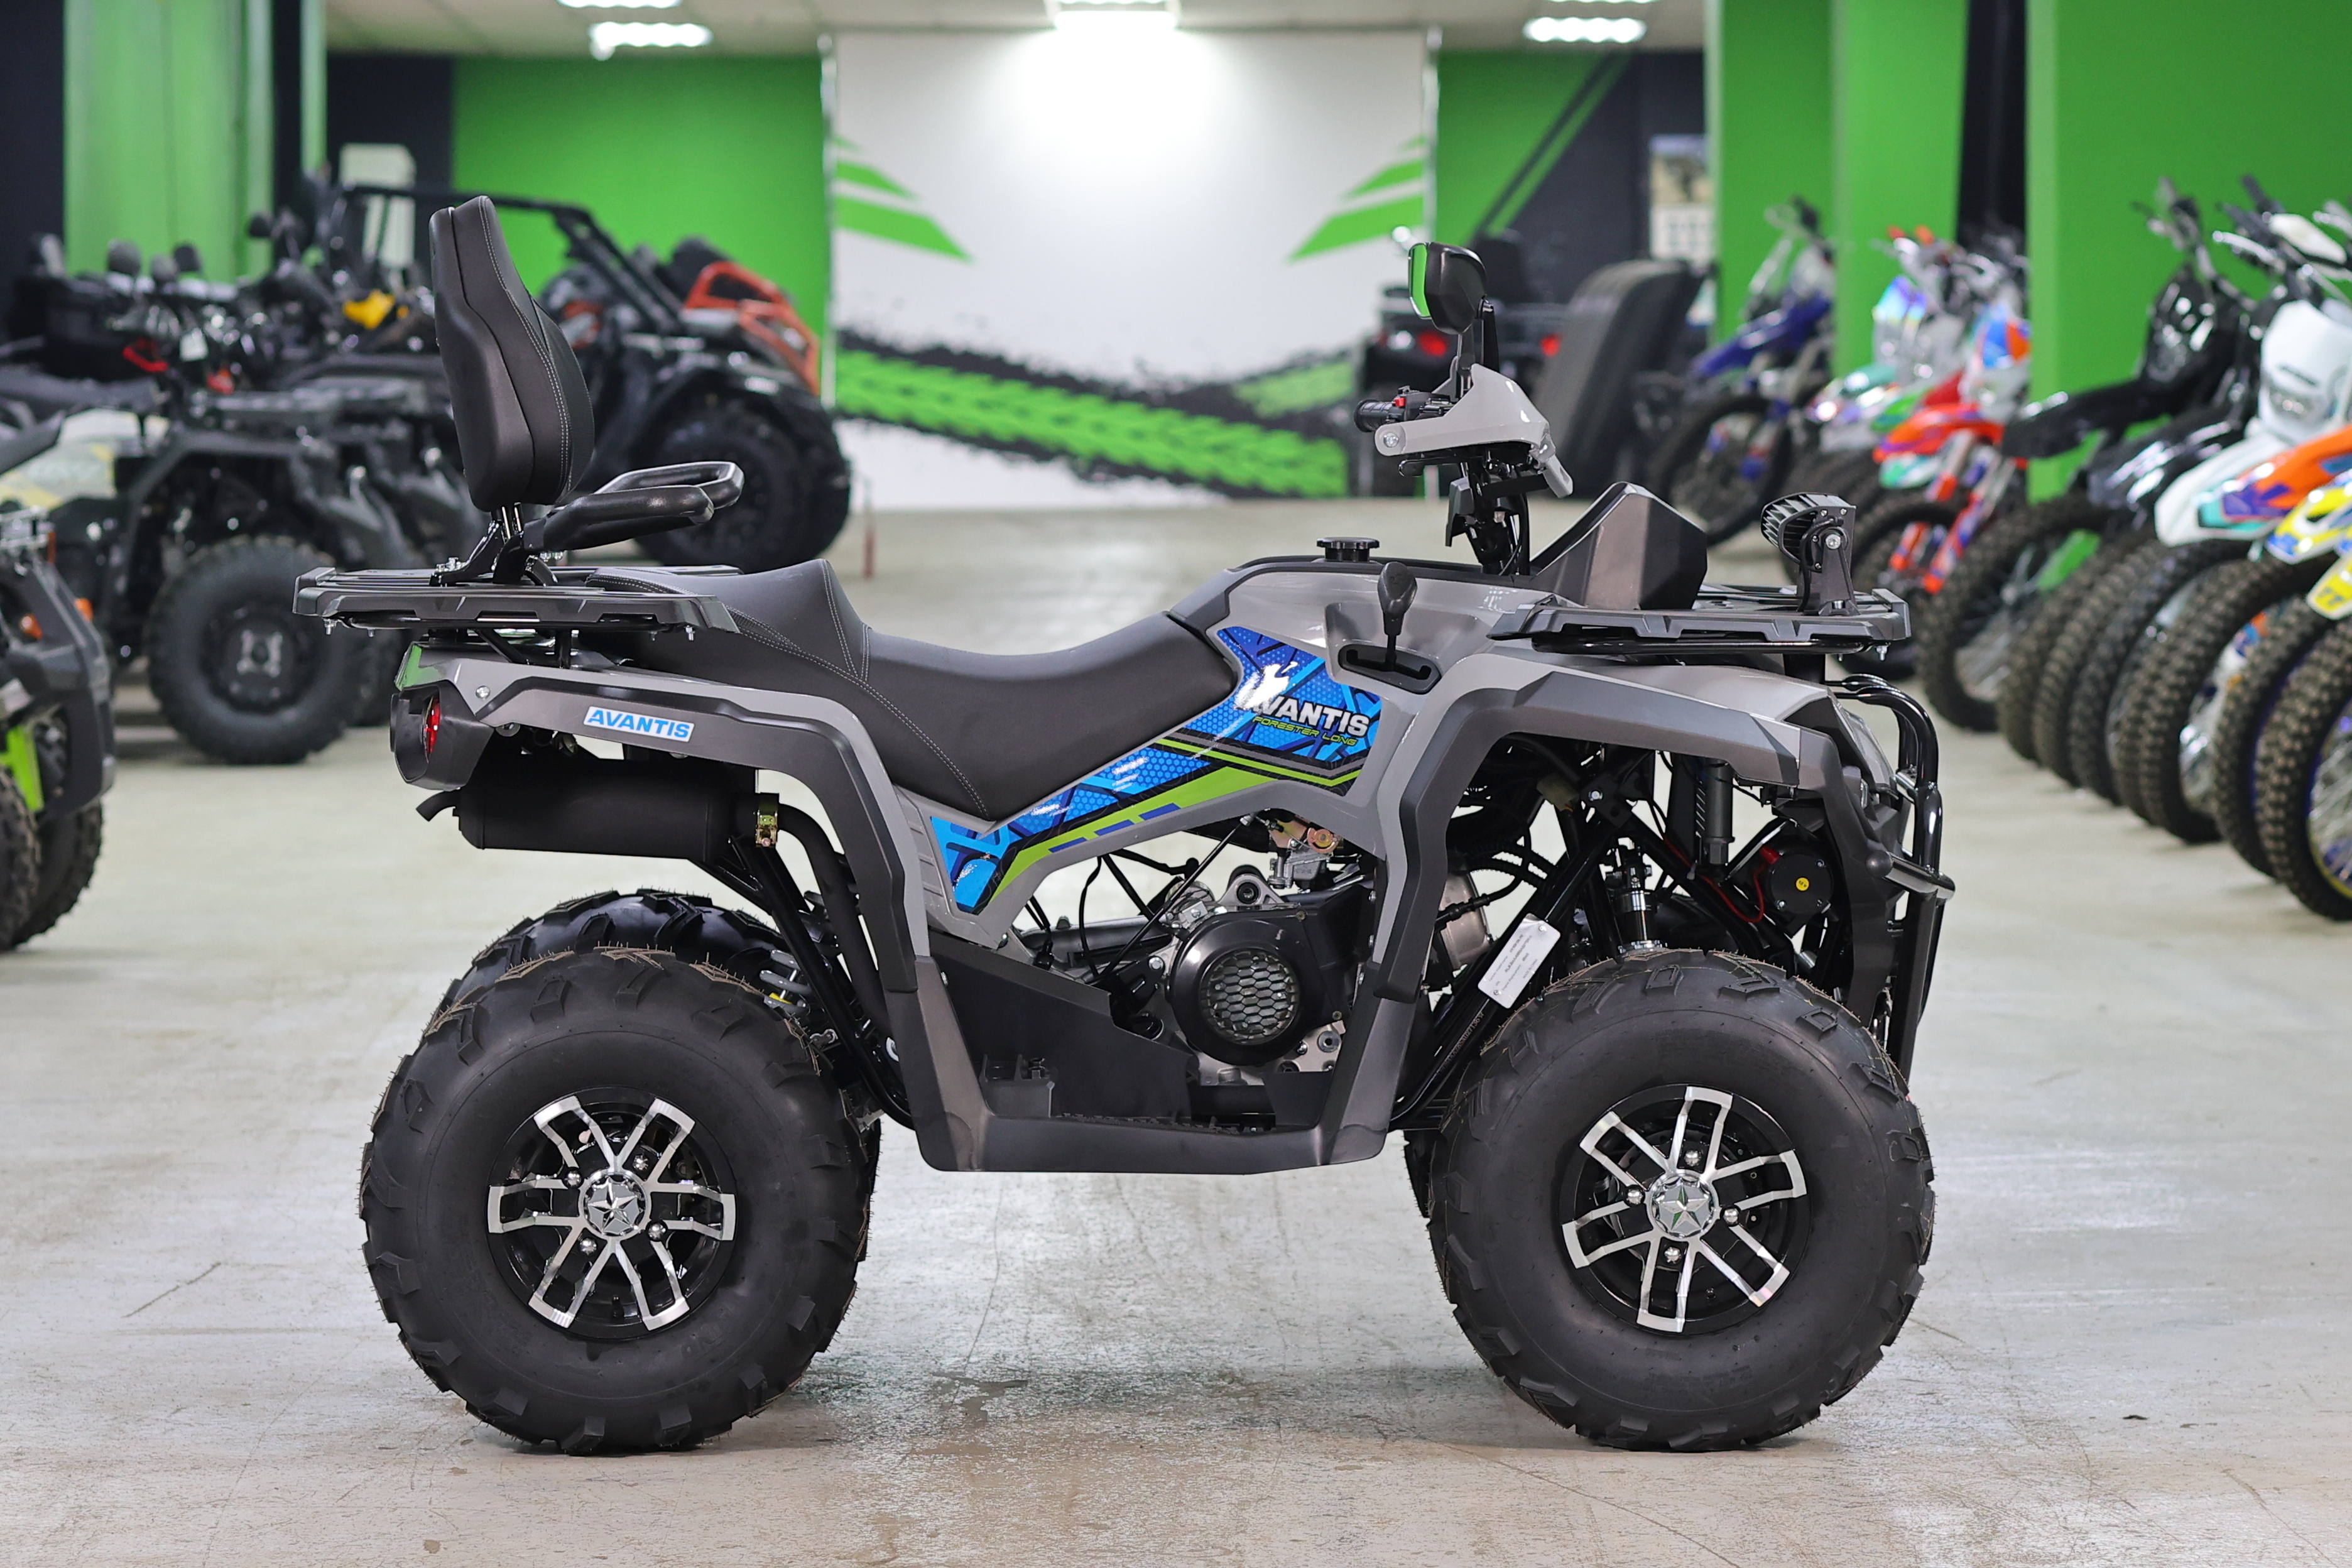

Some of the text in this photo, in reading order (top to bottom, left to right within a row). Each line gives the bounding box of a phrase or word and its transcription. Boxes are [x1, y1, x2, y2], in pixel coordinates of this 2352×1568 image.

[587, 709, 690, 738] AVANTIS
[1253, 694, 1369, 737] VANTIS
[1253, 716, 1358, 746] FORESTER LONG
